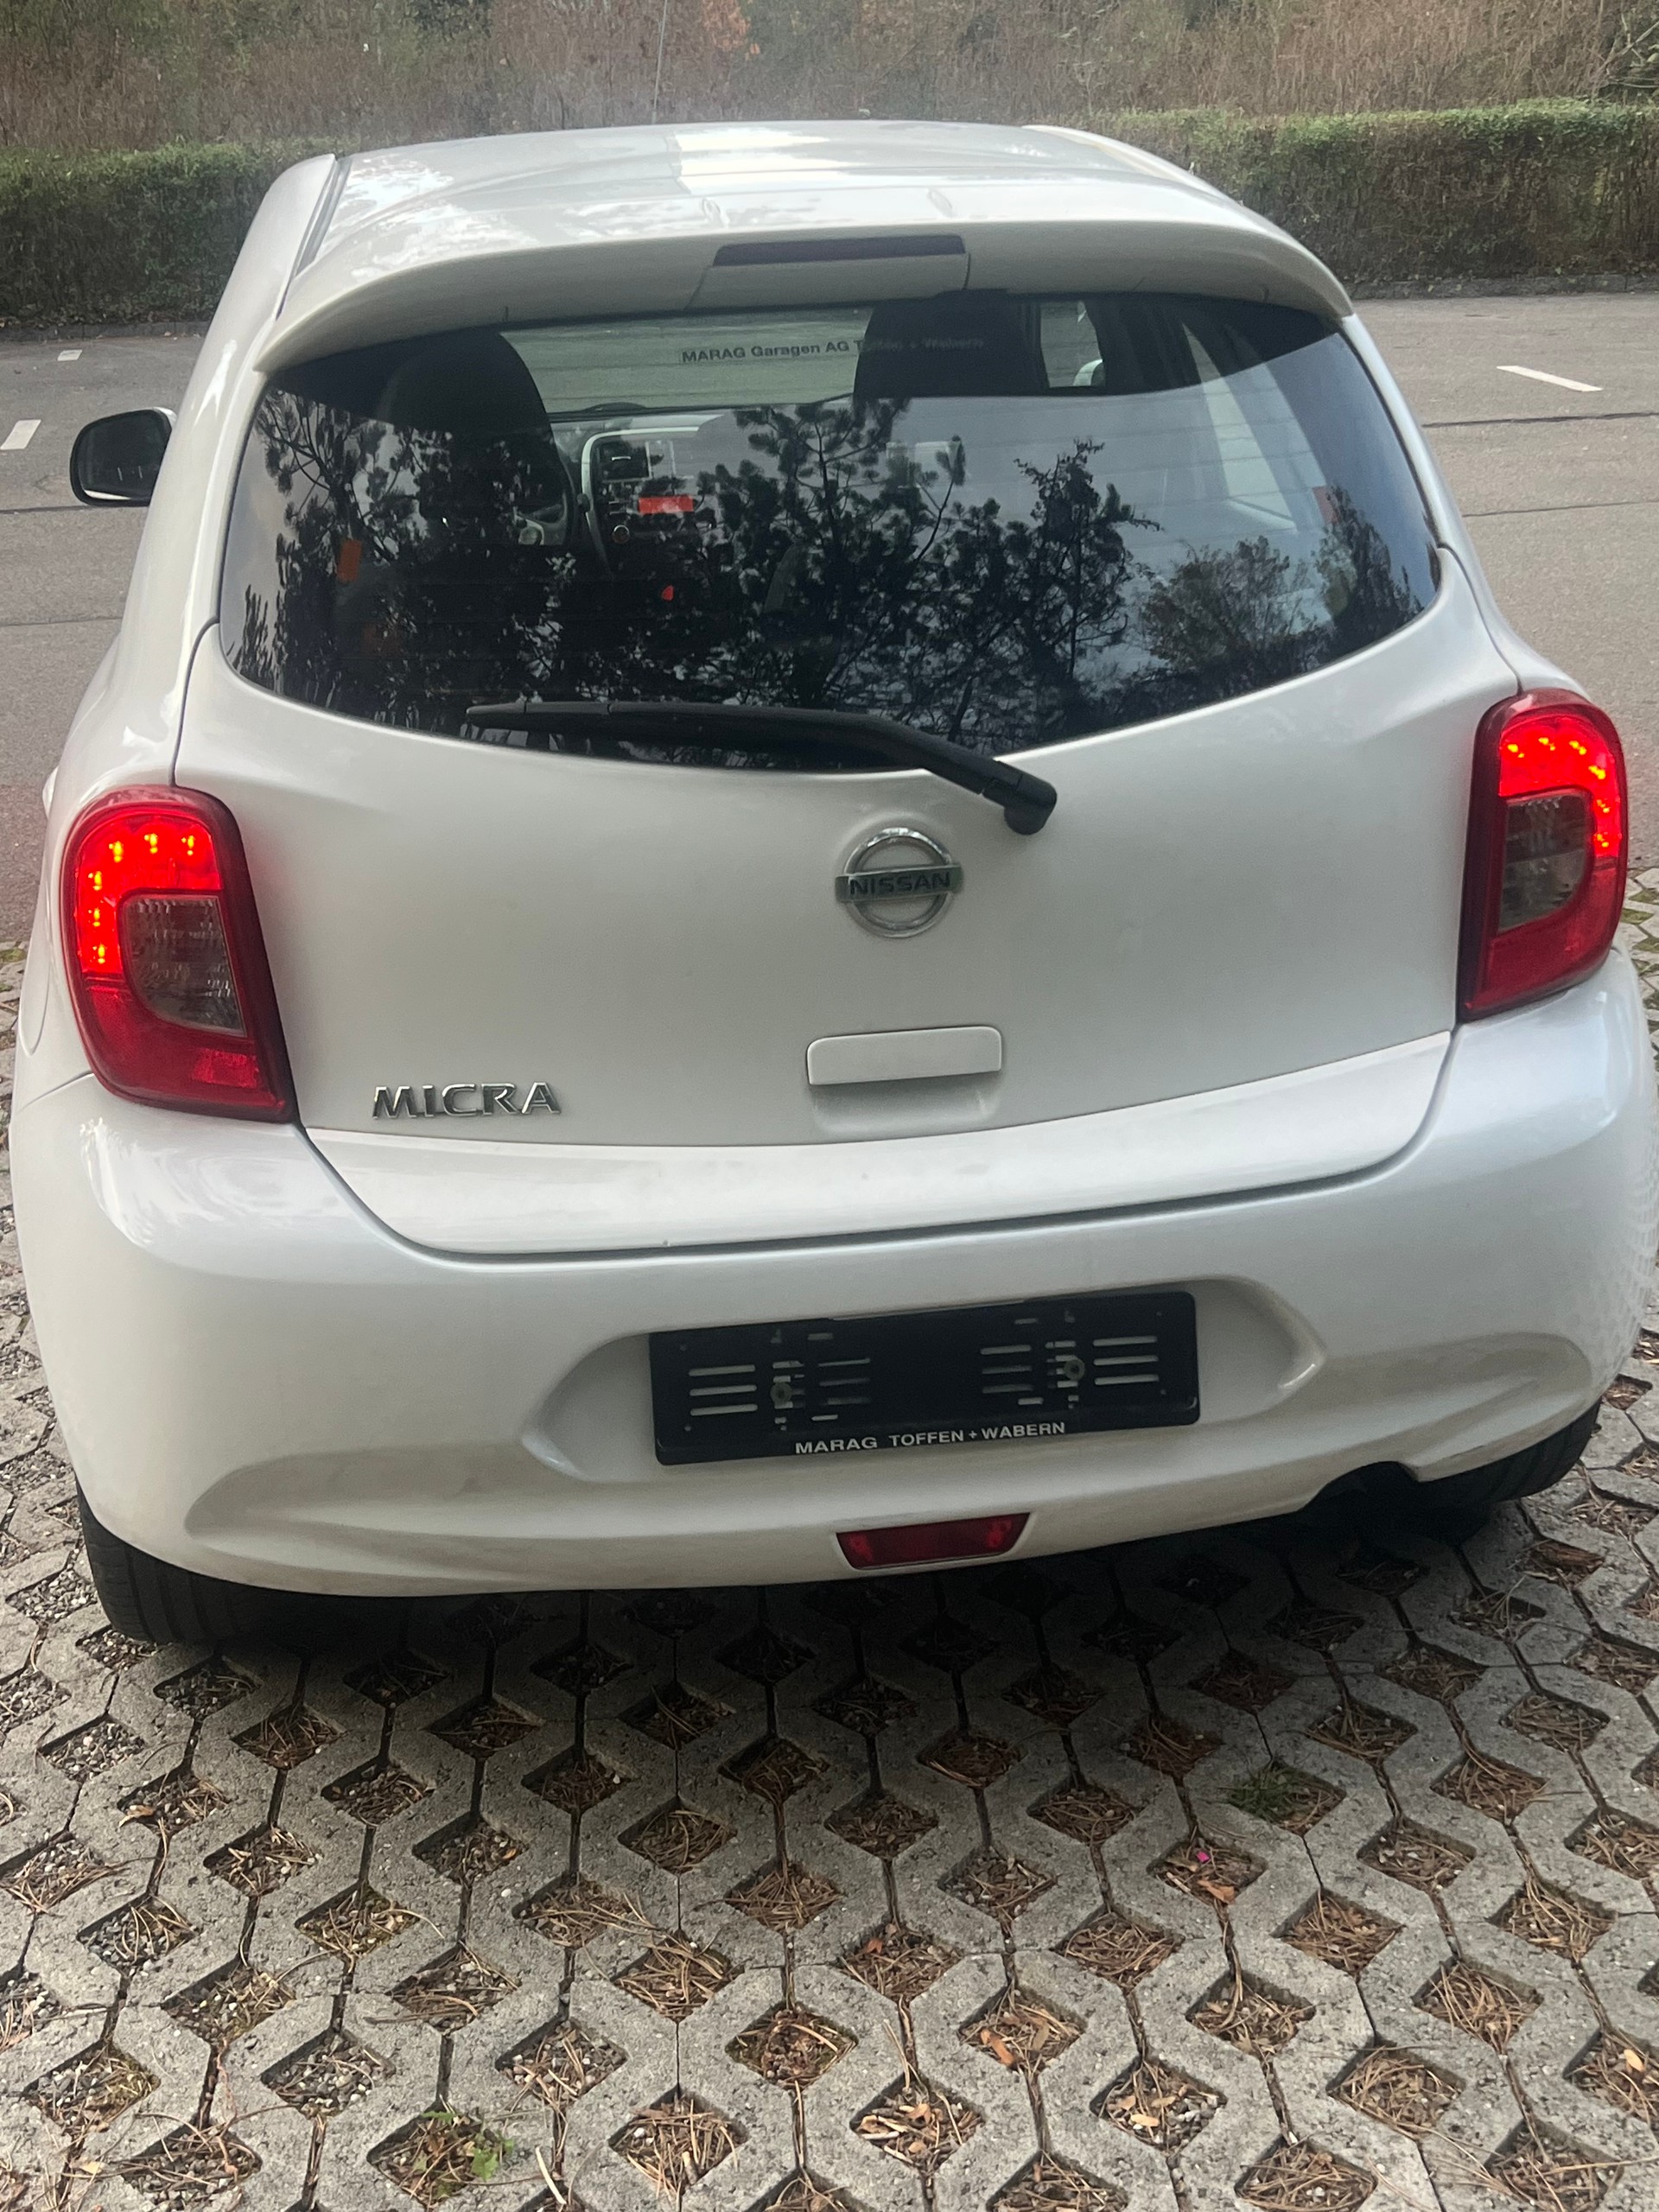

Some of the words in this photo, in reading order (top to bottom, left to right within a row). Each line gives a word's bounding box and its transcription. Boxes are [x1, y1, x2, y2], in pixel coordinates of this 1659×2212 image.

[682, 348, 747, 363] MARAG
[751, 343, 820, 358] Garagen
[824, 340, 850, 353] AG
[850, 872, 950, 894] NISSAN
[372, 1082, 561, 1119] MICRA
[795, 1436, 878, 1455] MARAG
[888, 1430, 964, 1447] TOFFEN
[982, 1422, 1065, 1440] WABERN
